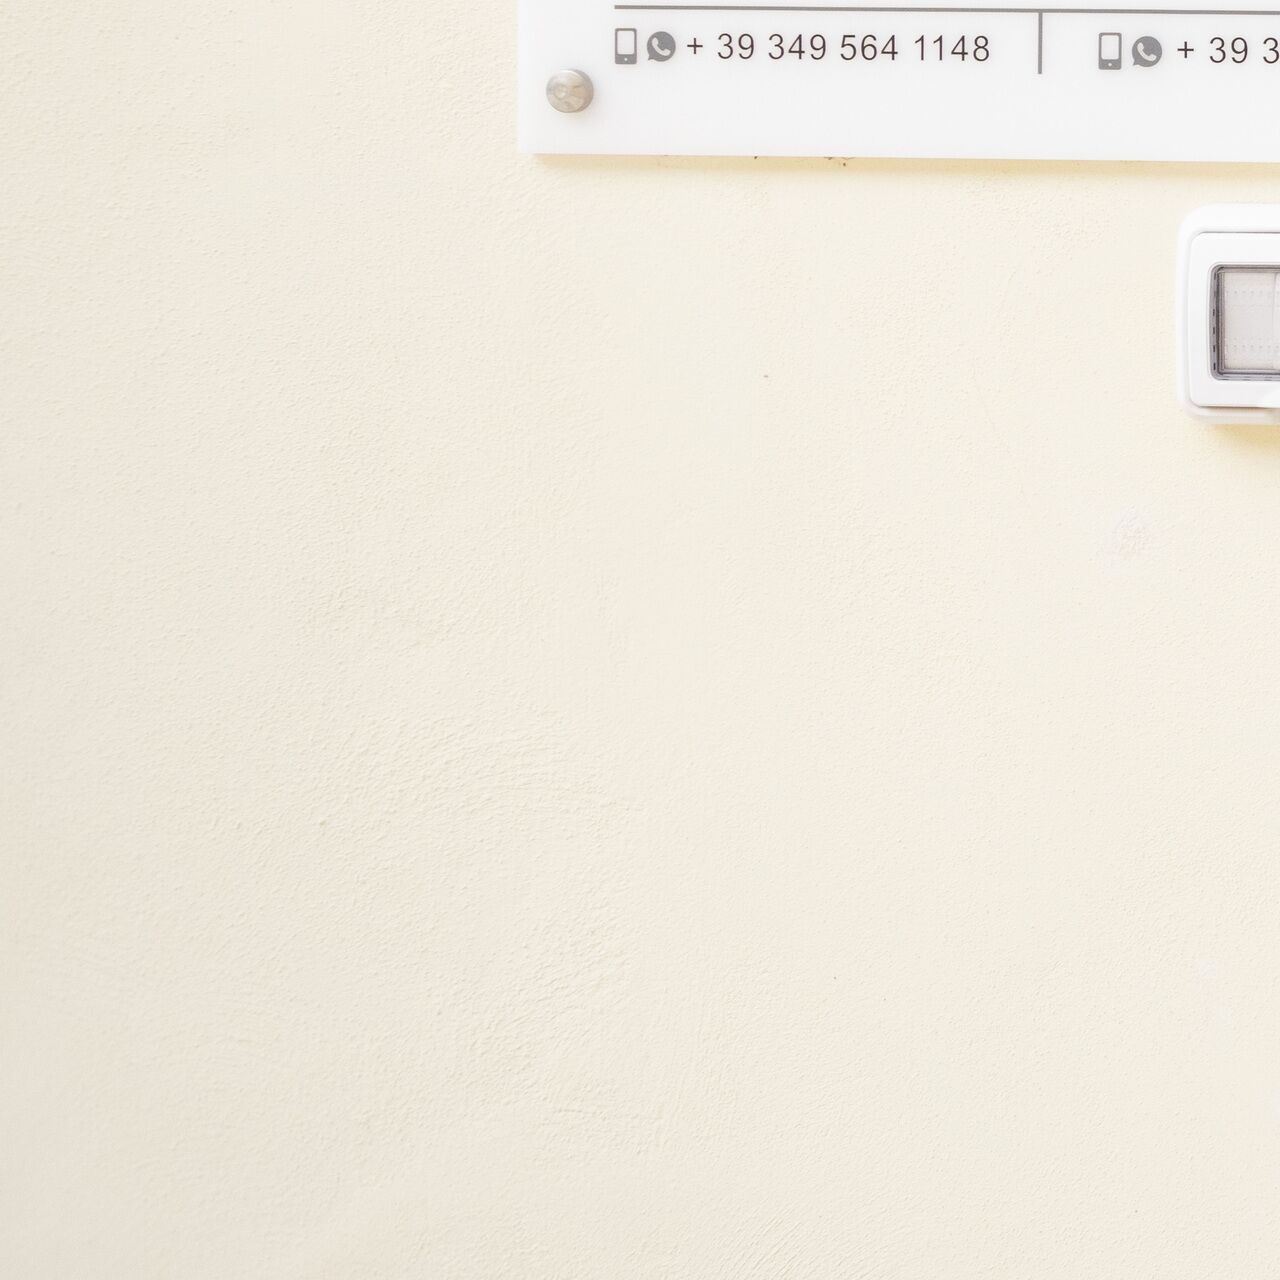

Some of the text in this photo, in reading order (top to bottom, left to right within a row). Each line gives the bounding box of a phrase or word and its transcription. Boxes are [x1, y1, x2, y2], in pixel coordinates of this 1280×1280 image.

[717, 32, 755, 60] 39
[768, 33, 827, 61] 349
[840, 34, 899, 61] 564
[914, 34, 990, 62] 1148
[1209, 36, 1248, 64] 39
